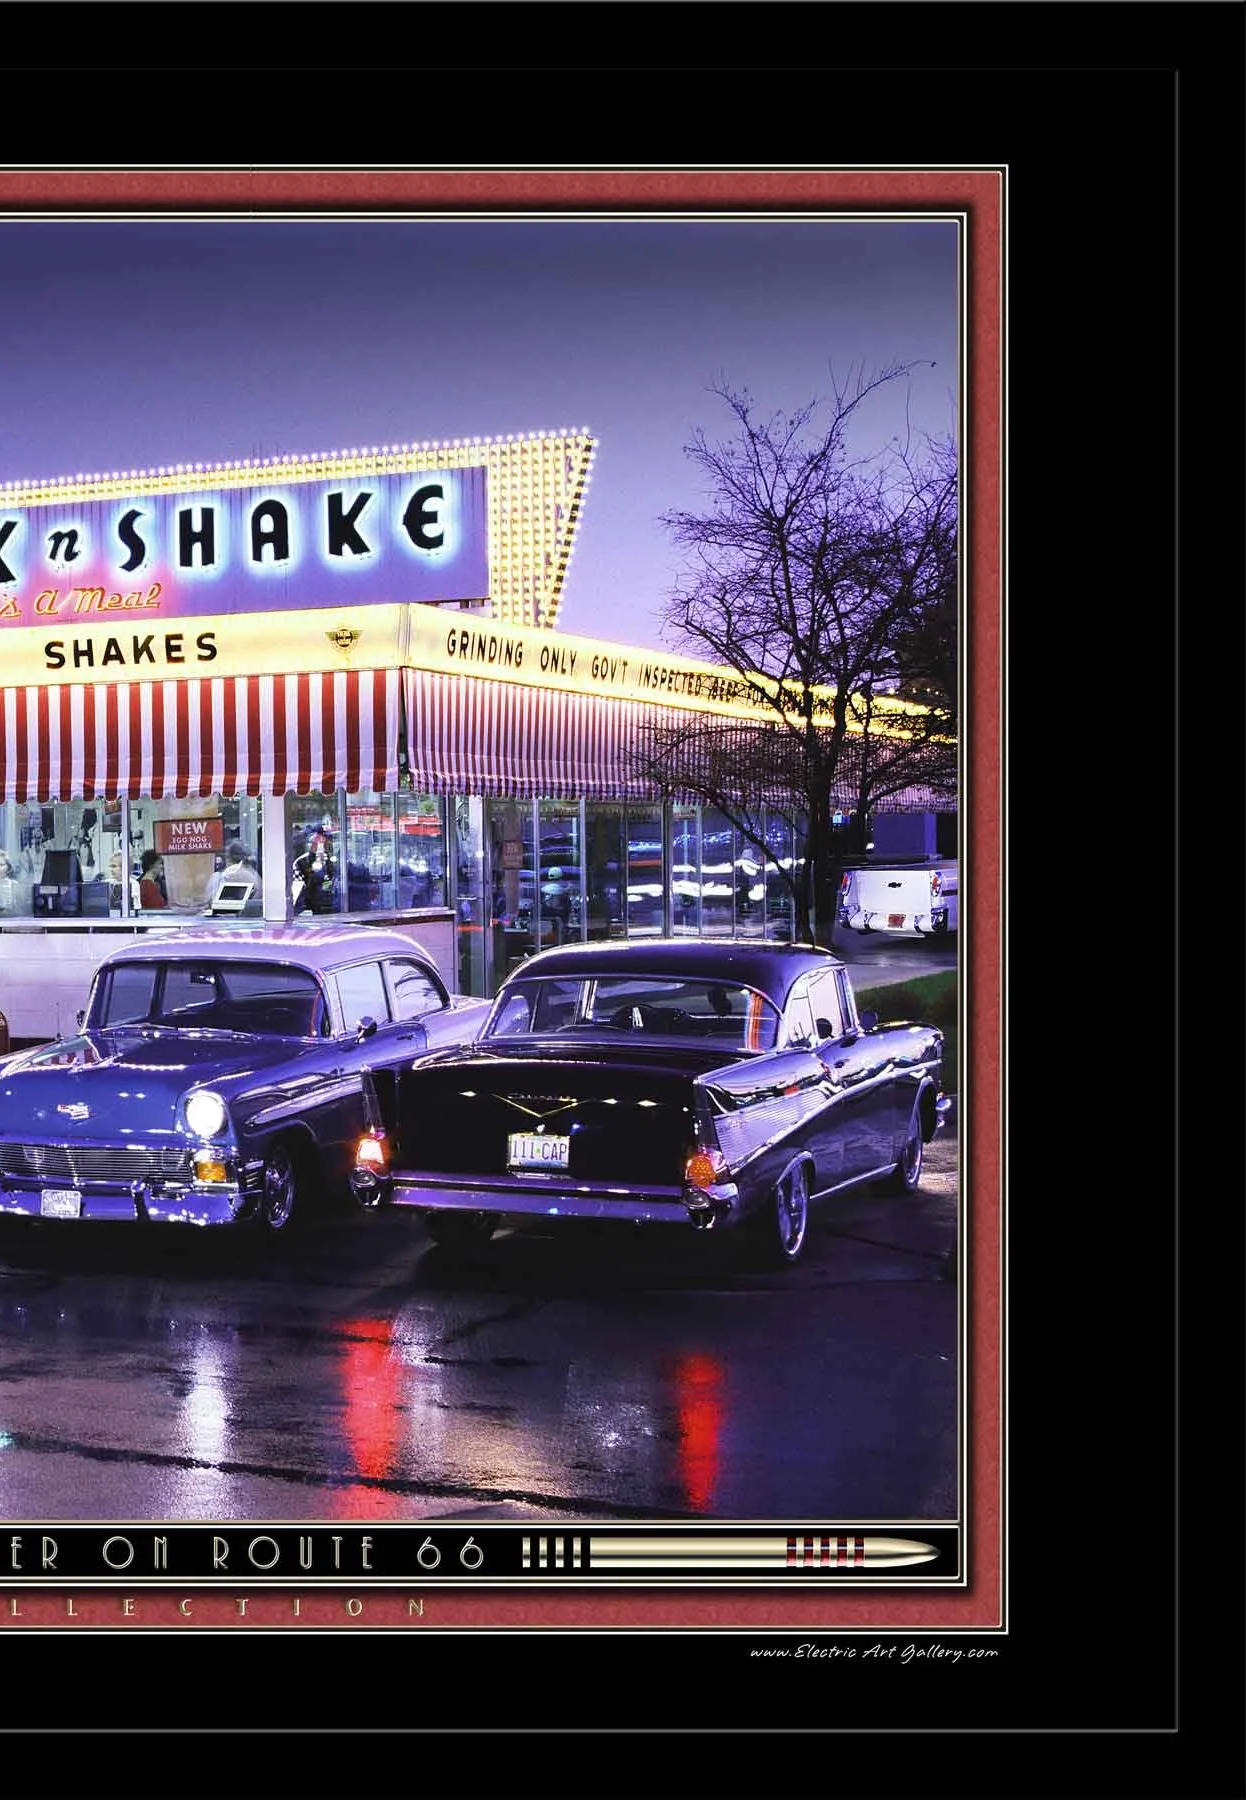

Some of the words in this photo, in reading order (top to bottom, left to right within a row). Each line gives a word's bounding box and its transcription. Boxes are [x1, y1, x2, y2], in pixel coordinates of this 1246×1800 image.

[48, 529, 79, 562] n
[117, 484, 445, 572] SHAKE
[44, 632, 218, 669] SHAKES
[447, 627, 523, 668] GRINDING
[540, 645, 577, 676] ONLY
[591, 654, 628, 685] GOV'T
[638, 663, 702, 697] INSPECTED
[171, 821, 207, 835] NEW
[542, 1142, 568, 1161] CAP
